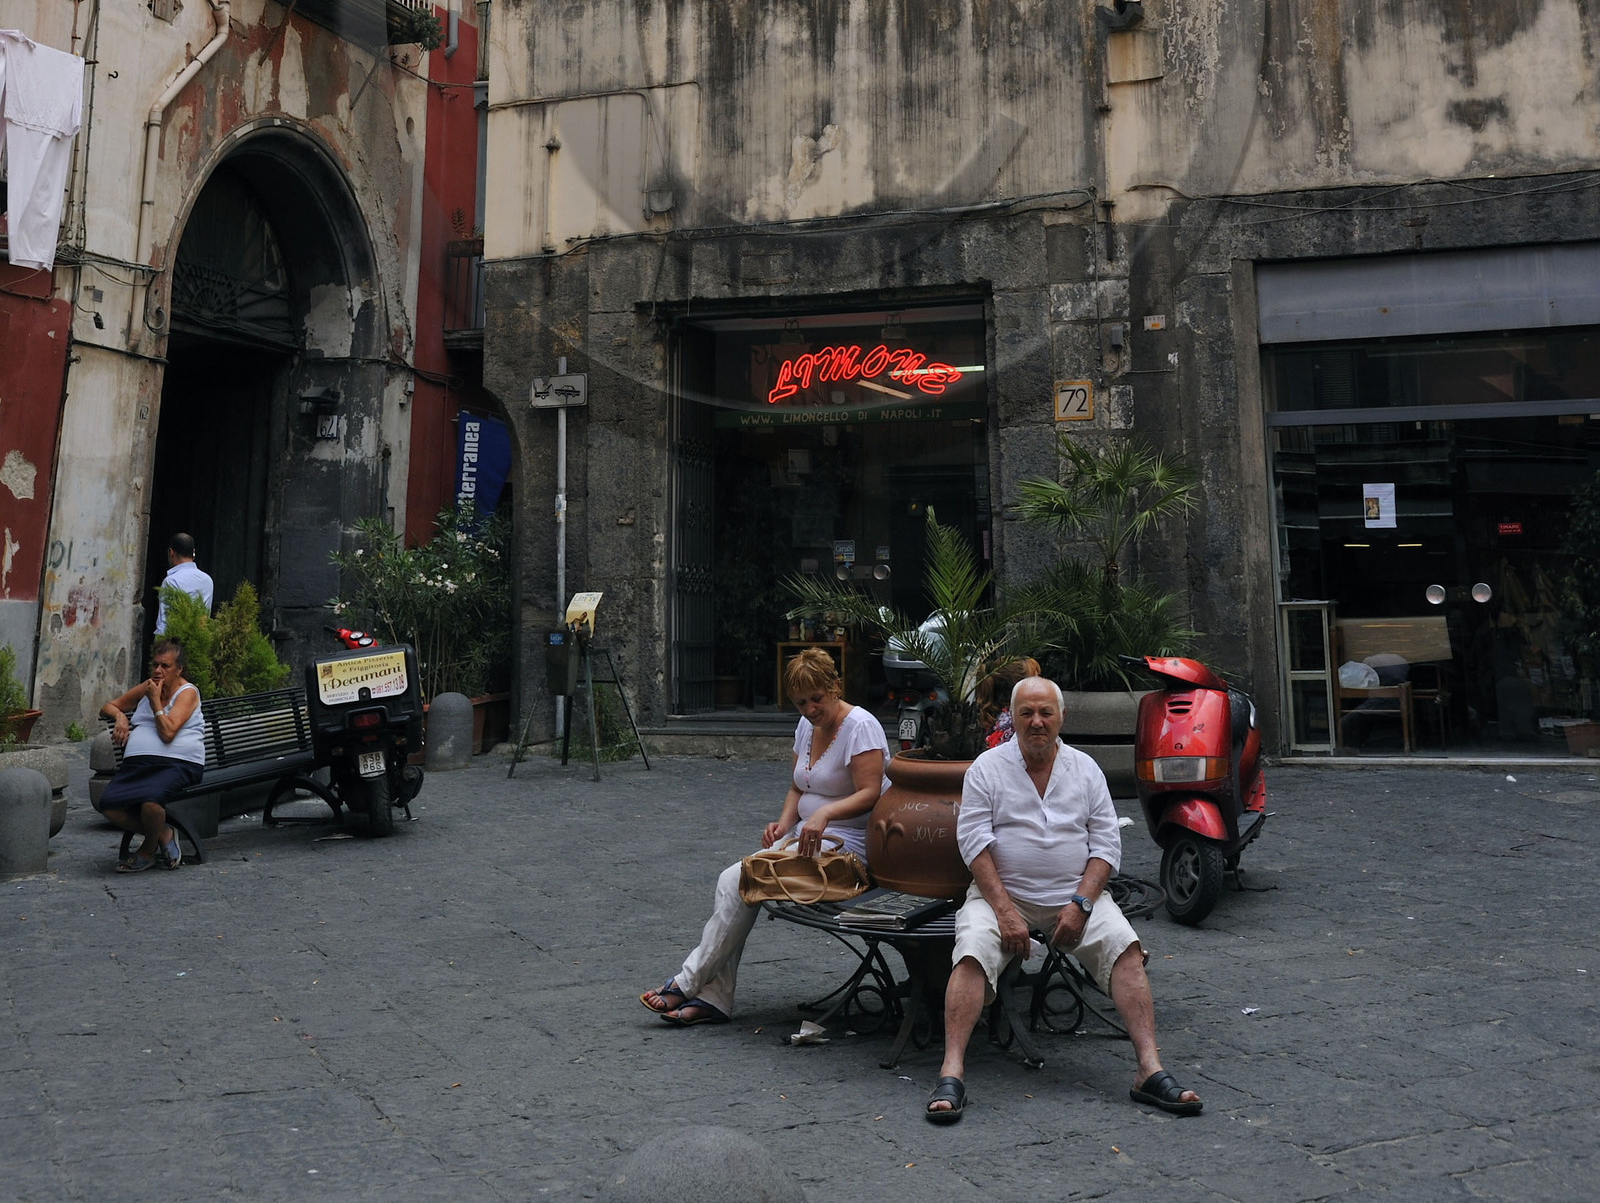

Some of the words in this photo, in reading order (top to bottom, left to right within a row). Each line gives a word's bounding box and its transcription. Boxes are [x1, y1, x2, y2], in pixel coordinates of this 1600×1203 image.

[768, 344, 962, 404] LIMONE
[1060, 388, 1088, 413] 72
[320, 414, 334, 438] 62
[782, 411, 849, 424] LIMONCELLO
[858, 410, 868, 421] DI
[881, 408, 922, 420] NAPOLI
[336, 658, 362, 668] Antica
[363, 655, 394, 664] Pizzeria
[349, 663, 389, 673] Friggitoria
[328, 663, 402, 690] Decumani
